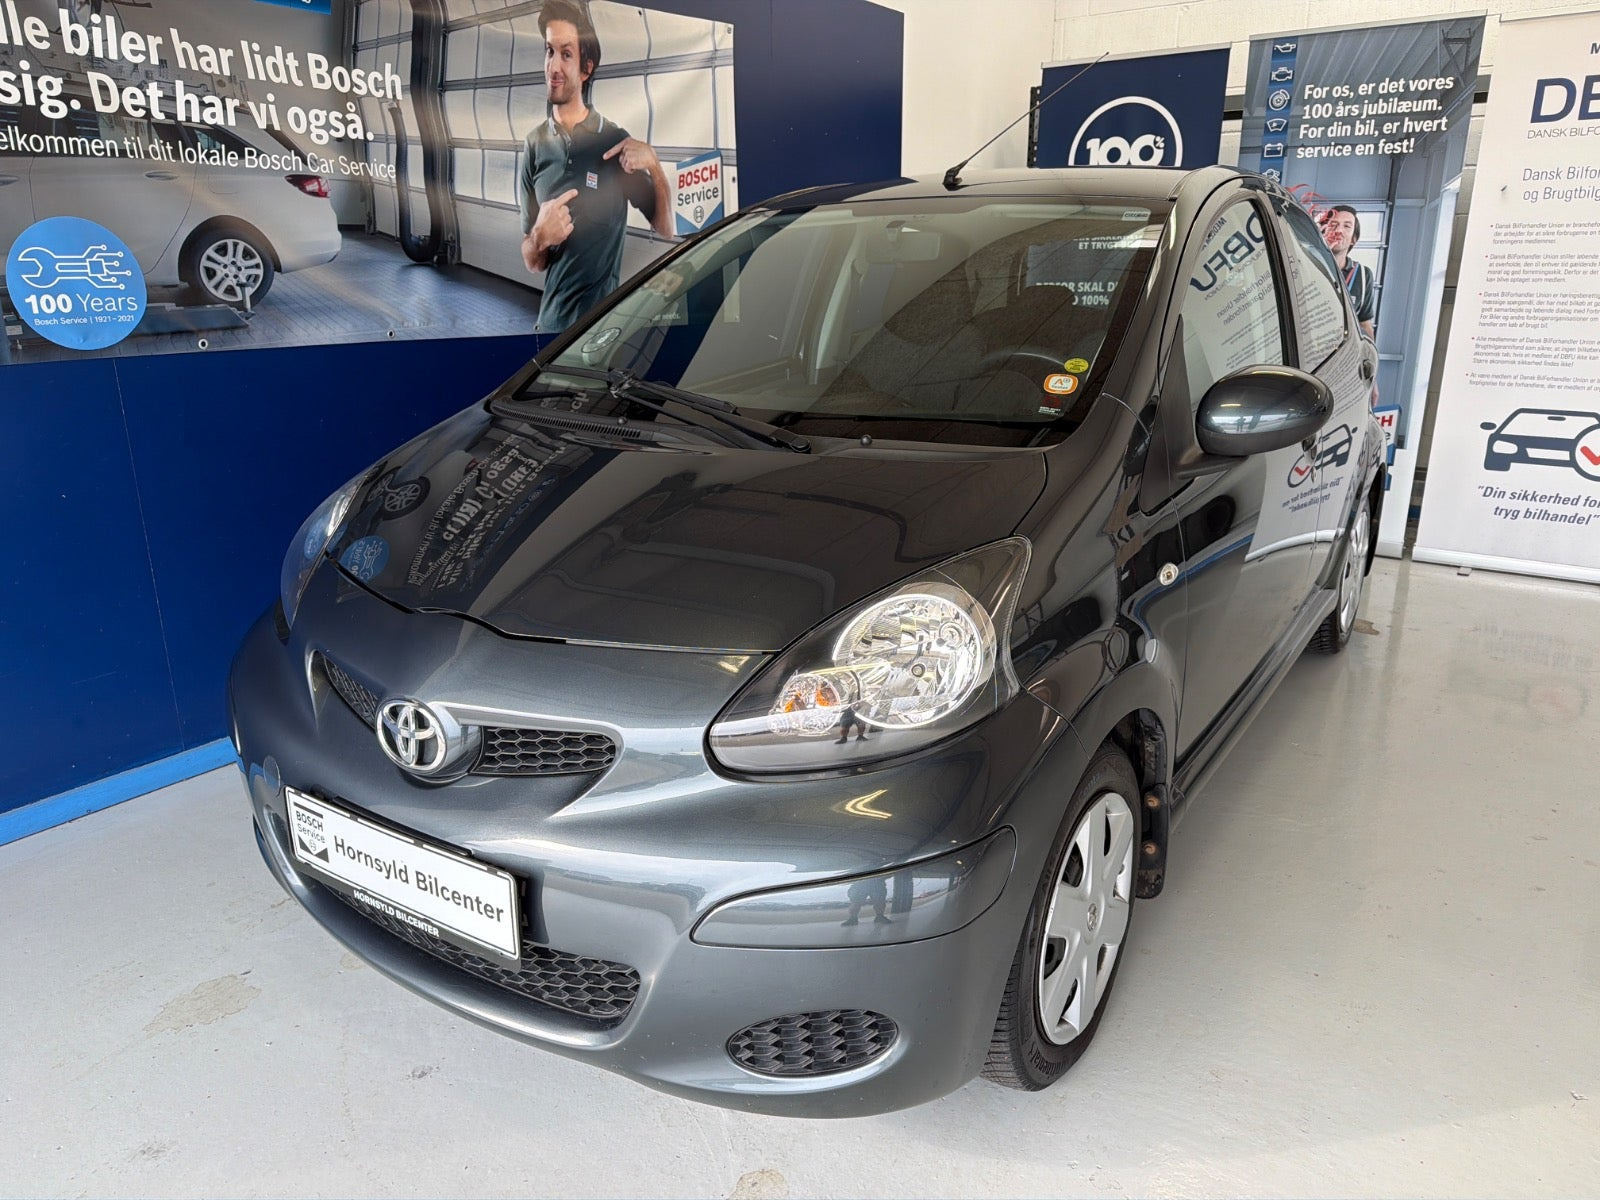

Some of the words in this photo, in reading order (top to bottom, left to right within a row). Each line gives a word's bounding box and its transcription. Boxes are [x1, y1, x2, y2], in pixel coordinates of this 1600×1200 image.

[59, 8, 164, 66] biler
[169, 28, 234, 77] har
[240, 39, 304, 86] lidt
[307, 52, 402, 100] Bosch
[1304, 84, 1330, 100] For
[1332, 85, 1354, 98] os,
[1358, 82, 1377, 96] er
[1378, 78, 1405, 95] det
[1409, 76, 1455, 91] vores
[0, 60, 81, 119] sig.
[86, 70, 167, 120] Det
[175, 80, 241, 127] har
[247, 93, 281, 131] vi
[287, 101, 375, 146] også.
[1302, 104, 1333, 120] 100
[1335, 100, 1360, 117] års
[1360, 99, 1443, 119] jubilæum.
[1299, 124, 1325, 139] For
[1327, 121, 1351, 137] din
[1354, 120, 1379, 137] bil,
[1382, 121, 1401, 134] er
[1403, 116, 1449, 133] hvert
[1527, 127, 1567, 139] DANSK
[123, 136, 145, 160] til
[149, 138, 175, 163] dit
[179, 141, 238, 168] lokale
[245, 148, 303, 172] Bosch
[307, 152, 335, 174] Car
[339, 158, 396, 179] Service
[1086, 133, 1165, 166] 100%
[1296, 142, 1351, 159] service
[1355, 143, 1374, 156] en
[1378, 138, 1415, 155] fest!
[678, 164, 719, 190] BOSCH
[1523, 168, 1563, 181] Dansk
[677, 185, 720, 207] Service
[1523, 189, 1538, 203] og
[1078, 242, 1088, 250] ET
[1077, 281, 1105, 292] SKAL
[24, 293, 73, 314] 100
[76, 293, 138, 313] Years
[1082, 295, 1110, 306] 100%
[34, 318, 59, 326] Bosch
[60, 316, 88, 325] Service
[1508, 489, 1581, 506] sikkerhed
[1493, 506, 1521, 520] tryg
[295, 810, 324, 833] BOSCH
[297, 823, 326, 844] Service
[333, 834, 410, 885] Hornsyld
[415, 870, 505, 923] Bilcenter
[353, 889, 395, 917] HORNSYLD
[396, 910, 440, 938] BILCENTER
